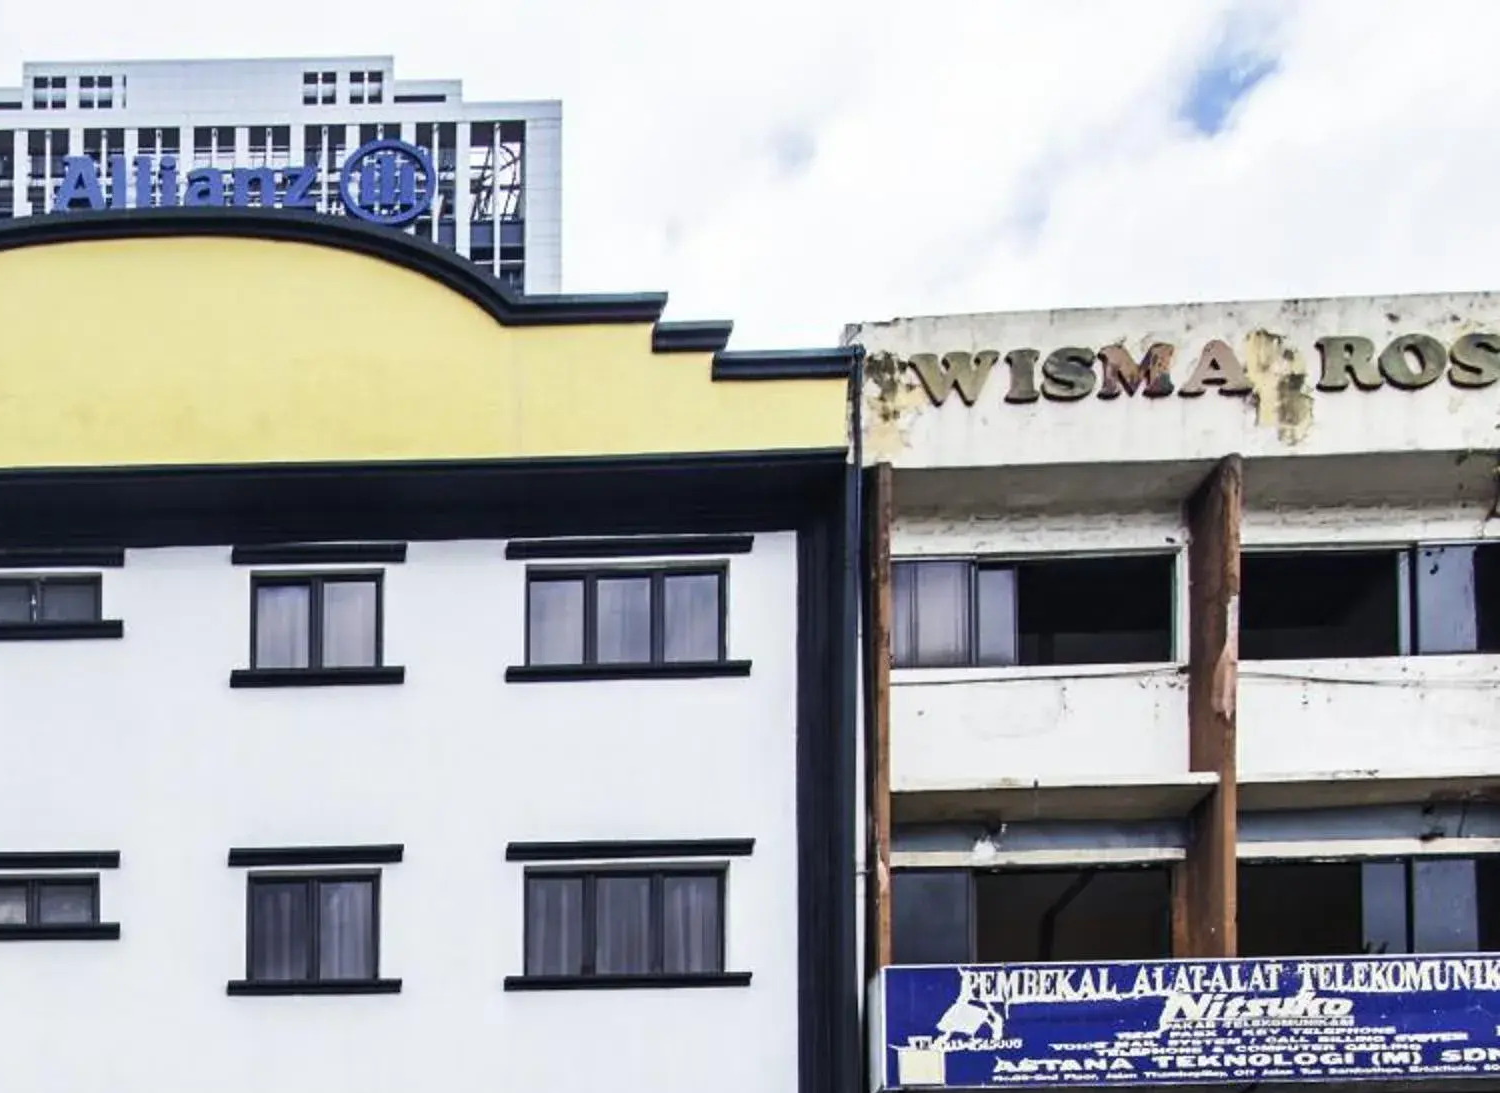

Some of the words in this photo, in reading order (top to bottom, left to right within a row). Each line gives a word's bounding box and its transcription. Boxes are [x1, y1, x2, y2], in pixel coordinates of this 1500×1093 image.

[51, 153, 321, 211] Allianz
[907, 339, 1253, 407] WISMA
[1314, 332, 1500, 392] ROS
[961, 967, 1117, 1003] PEMBEKAL
[1132, 962, 1281, 998] ALAT-ALAT
[1162, 991, 1354, 1018] Nitsuko
[993, 1056, 1135, 1073] ASTANA
[1152, 1052, 1353, 1069] TEKNOLOGI
[1371, 1051, 1422, 1066] (M)
[1235, 1044, 1336, 1053] COMPUTER
